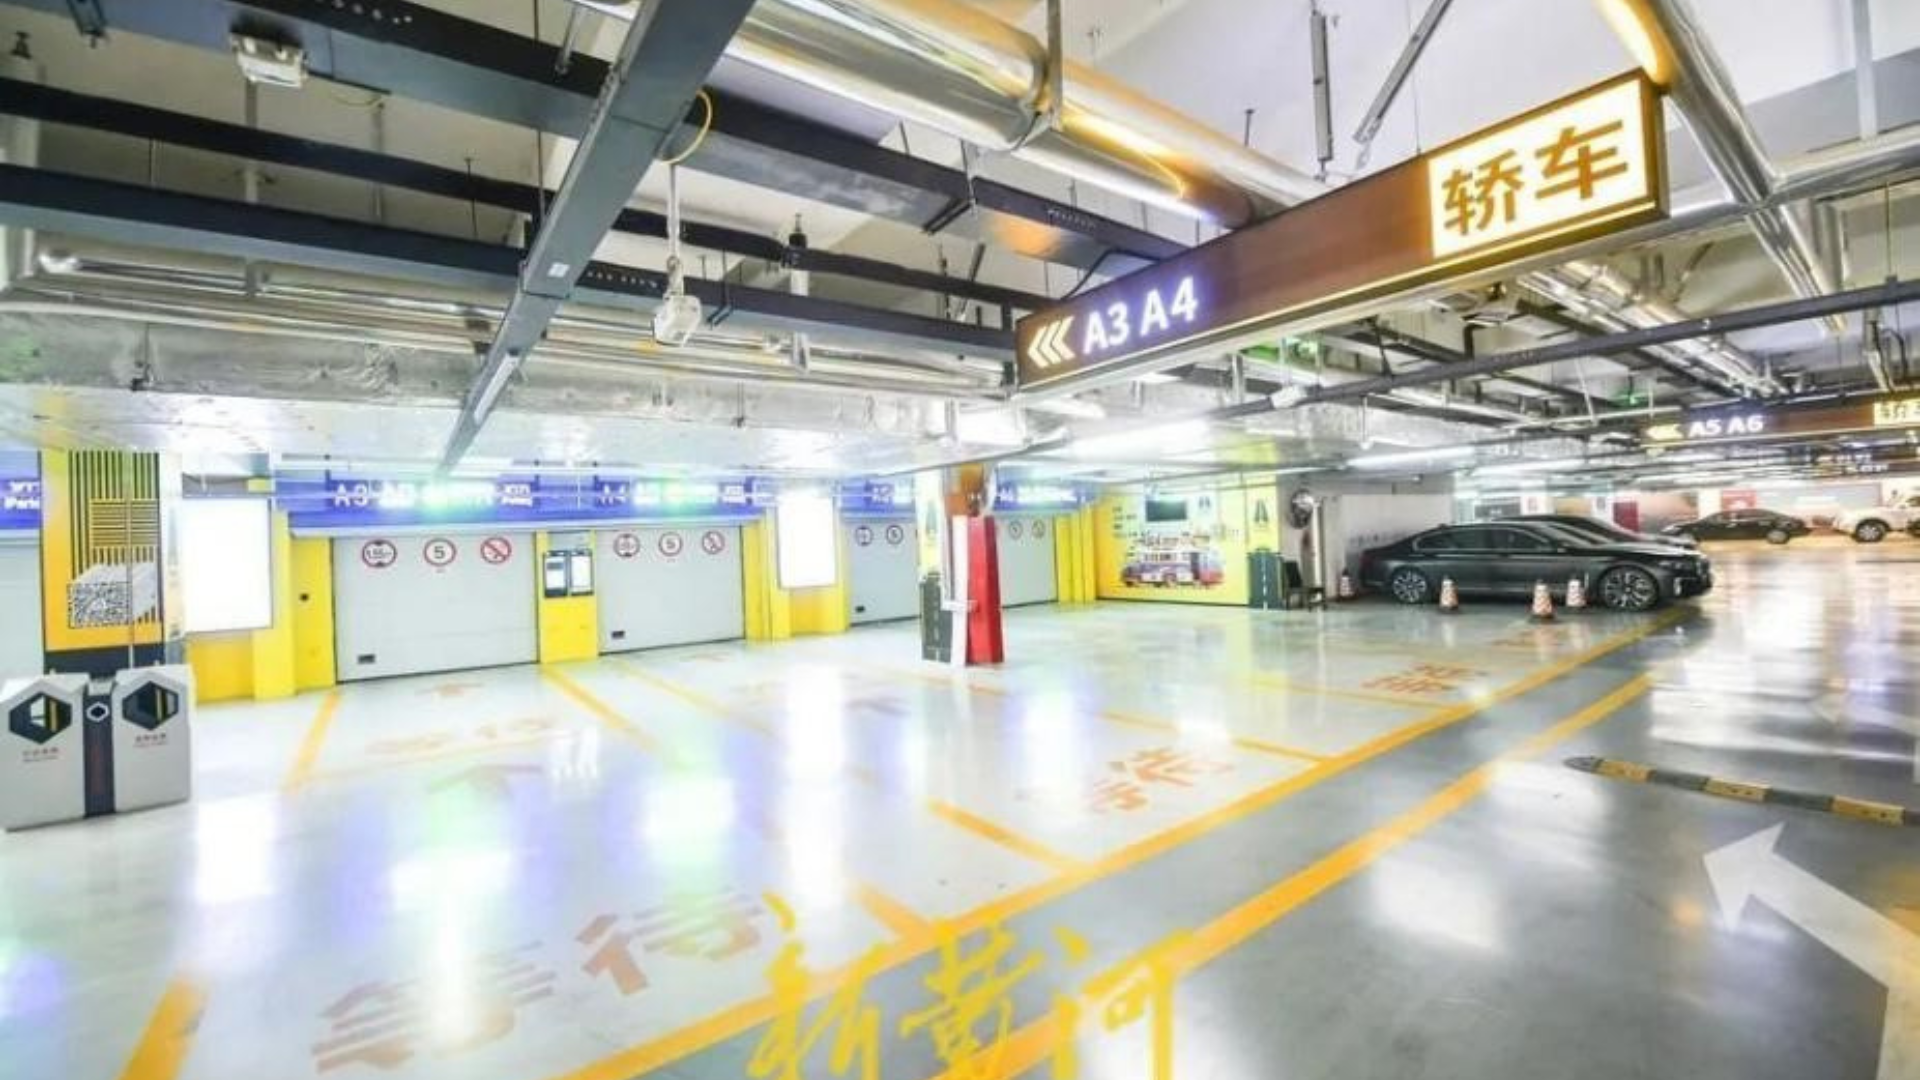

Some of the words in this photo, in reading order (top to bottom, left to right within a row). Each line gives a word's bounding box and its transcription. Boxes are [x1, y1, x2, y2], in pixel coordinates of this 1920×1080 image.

[1441, 118, 1629, 236] 轿车
[1082, 301, 1131, 354] A3
[1139, 275, 1199, 340] A4
[1688, 419, 1722, 438] A5
[1727, 414, 1764, 435] A6
[433, 545, 446, 559] 5
